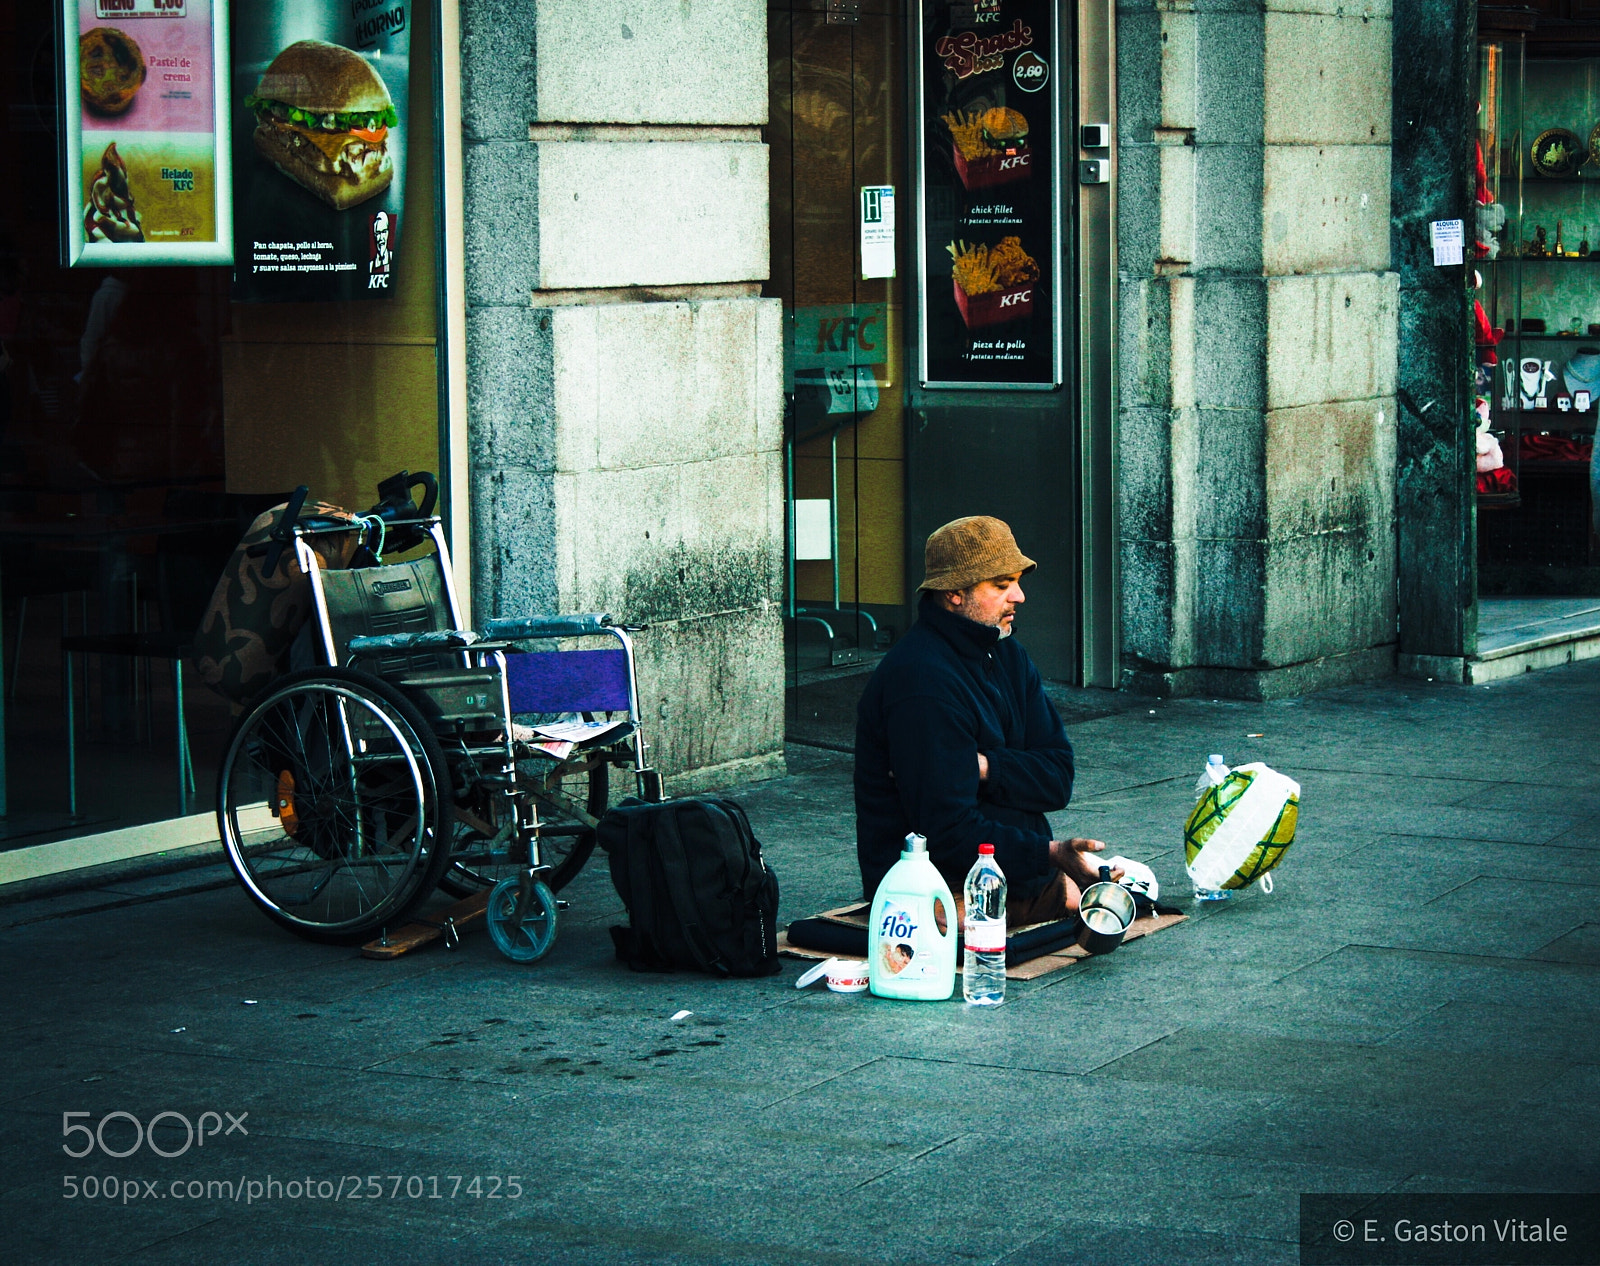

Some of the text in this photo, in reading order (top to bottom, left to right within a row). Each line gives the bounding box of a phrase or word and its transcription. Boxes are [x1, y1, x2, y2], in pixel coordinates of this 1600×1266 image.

[975, 12, 1000, 23] KFC
[358, 7, 403, 41] HORNO
[936, 19, 1033, 79] Snack
[150, 56, 191, 68] Pastel de
[163, 73, 191, 82] crema
[1016, 66, 1043, 79] 2,60
[999, 154, 1030, 171] KFC
[161, 168, 193, 179] Helado
[173, 180, 194, 191] KFC
[253, 242, 267, 250] Pan
[268, 241, 295, 251] chapata,
[253, 253, 279, 262] tomate,
[253, 265, 259, 273] y
[280, 264, 297, 272] salsa
[368, 274, 390, 289] KFC
[1000, 290, 1031, 308] KFC
[816, 316, 877, 354] KFC
[972, 340, 1026, 351] pieza de pollo
[881, 916, 918, 938] flor
